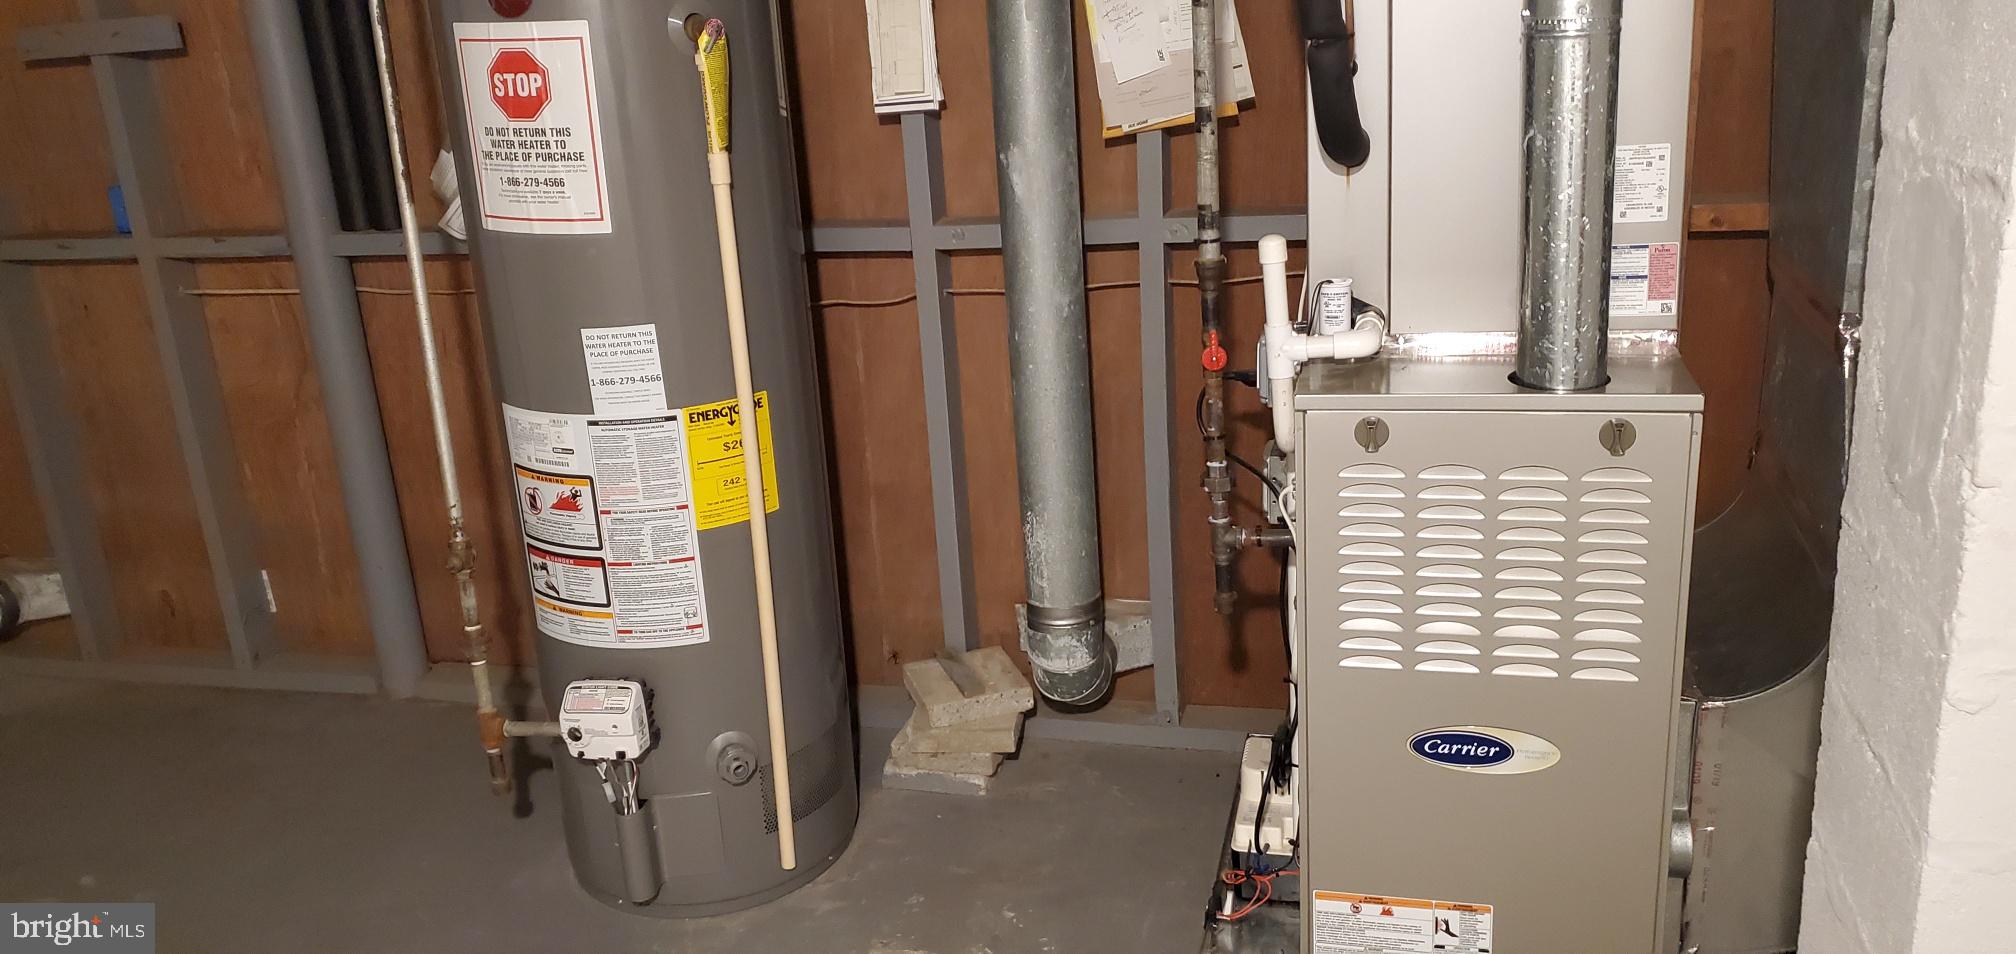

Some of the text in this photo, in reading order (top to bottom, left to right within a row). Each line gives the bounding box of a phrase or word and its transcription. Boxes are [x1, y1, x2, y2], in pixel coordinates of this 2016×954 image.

[493, 72, 542, 97] STOP
[484, 126, 571, 137] DO NOT RETURN THIS
[490, 139, 567, 150] WATER HEATER TO
[481, 150, 585, 162] THE PLACE OF PURCHASE
[499, 176, 566, 188] 1-866-279-4566
[611, 332, 637, 340] RETURN
[585, 342, 607, 350] WATER
[607, 341, 632, 349] HEATER
[589, 350, 608, 358] PLACE
[619, 348, 654, 356] PURCHASE
[590, 373, 662, 387] 1-866-279-4566
[688, 397, 764, 426] ENERGYGE
[536, 475, 565, 484] WARNING
[722, 476, 741, 487] 242
[551, 555, 575, 564] DANGER
[558, 606, 583, 616] WARNING
[1423, 739, 1500, 757] Carrier
